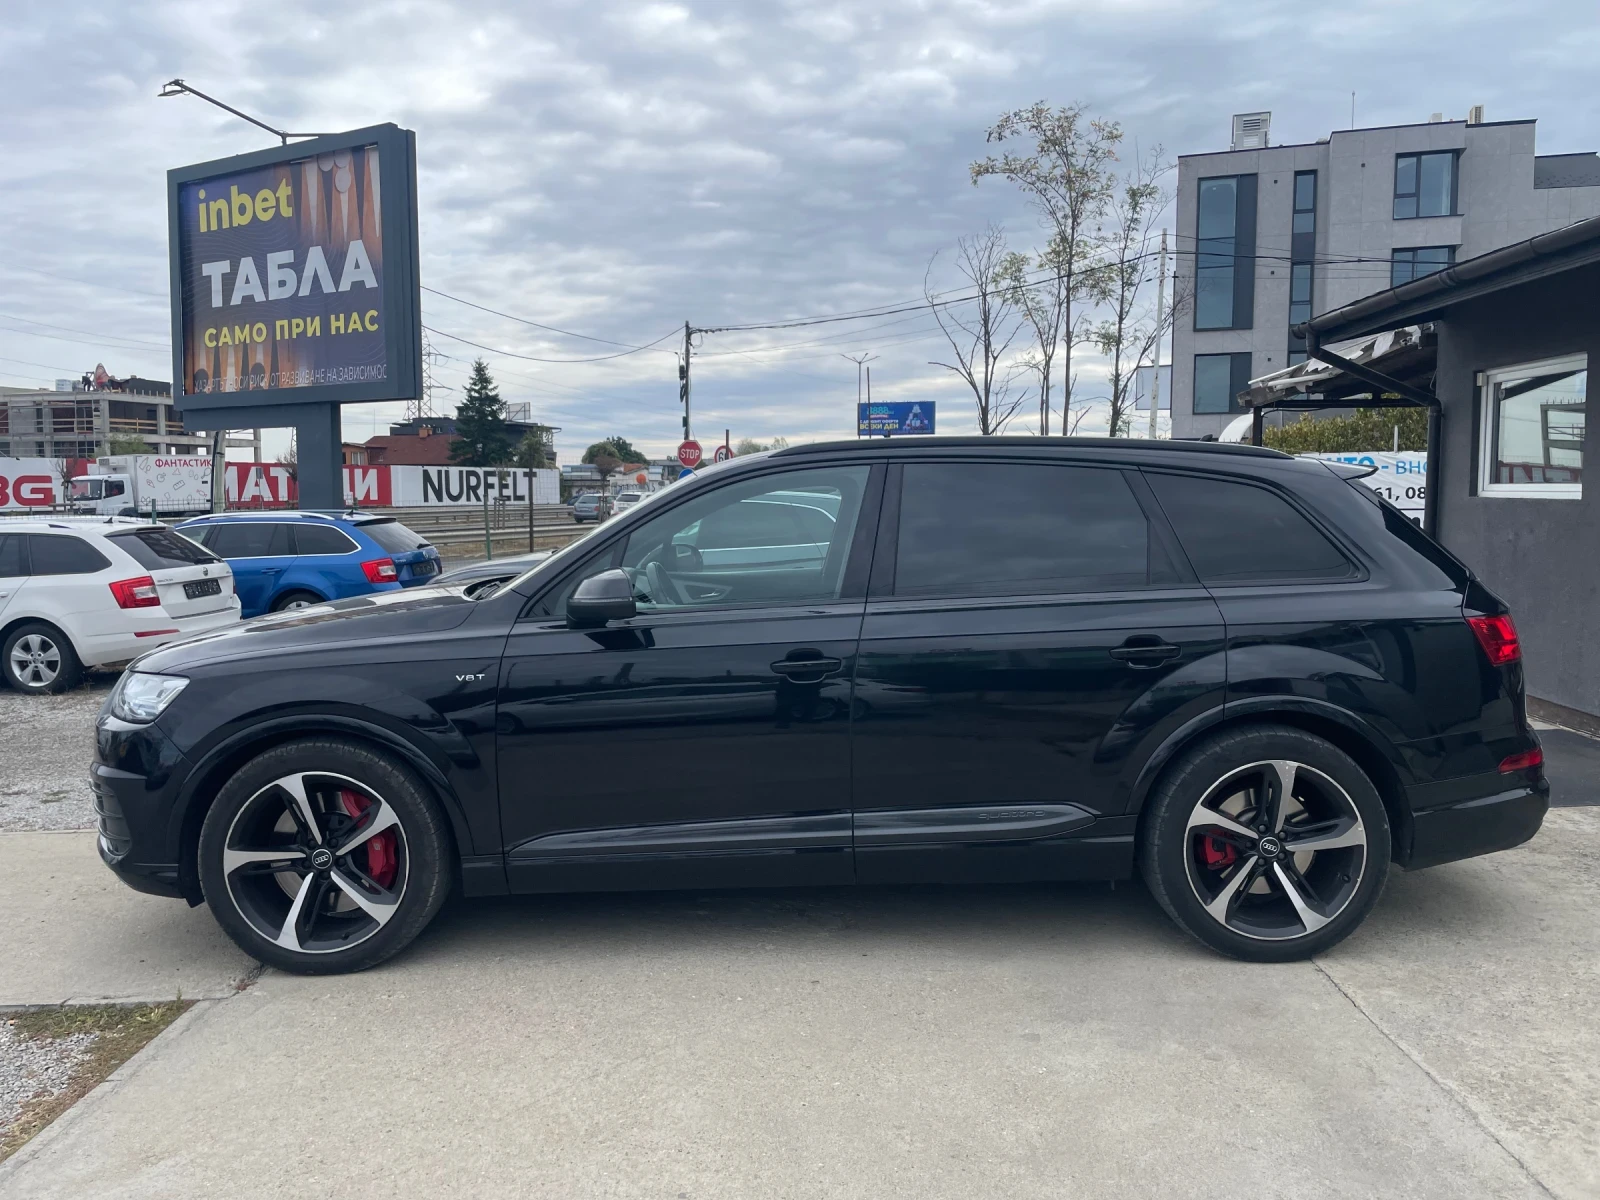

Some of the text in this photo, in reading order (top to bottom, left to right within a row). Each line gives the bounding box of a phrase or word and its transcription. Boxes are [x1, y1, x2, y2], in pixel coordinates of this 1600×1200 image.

[199, 178, 292, 232] inbet
[202, 240, 378, 308] ТАБЛА
[204, 309, 378, 347] САМО ПРИ НАС
[270, 372, 280, 385] ОТ
[281, 369, 325, 384] РАЗВИВАНЕ
[327, 368, 337, 381] НА
[680, 449, 700, 459] STOP
[0, 475, 53, 507] G
[422, 469, 537, 502] NURFELT
[978, 810, 1046, 820] quattro
